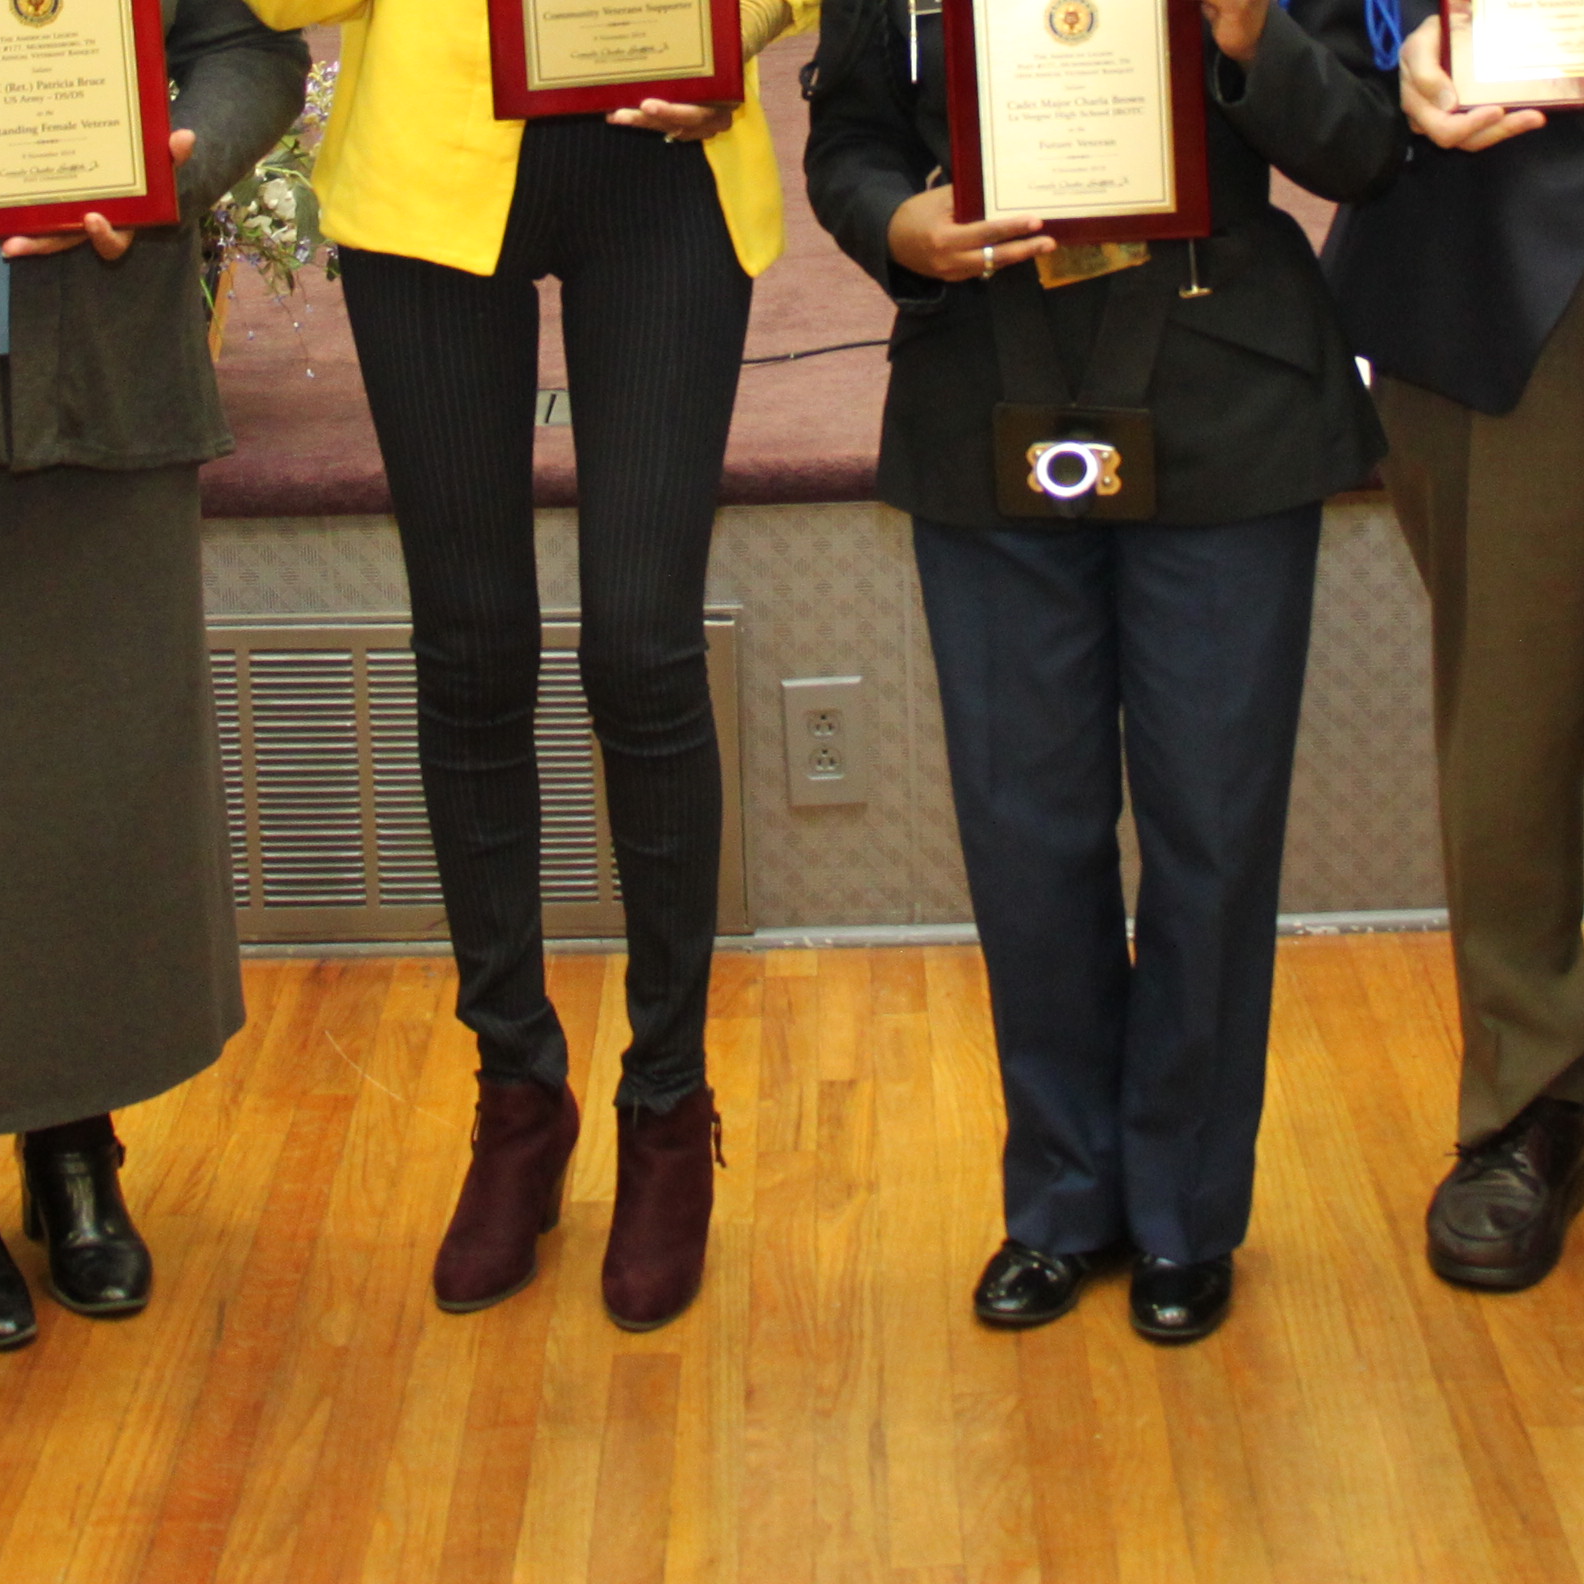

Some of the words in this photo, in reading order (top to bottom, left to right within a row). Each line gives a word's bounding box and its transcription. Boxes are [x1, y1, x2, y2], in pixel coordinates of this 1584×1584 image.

[36, 79, 74, 90] Patricia
[78, 77, 105, 86] Bruce
[41, 121, 77, 132] Female
[81, 119, 120, 128] Veteran
